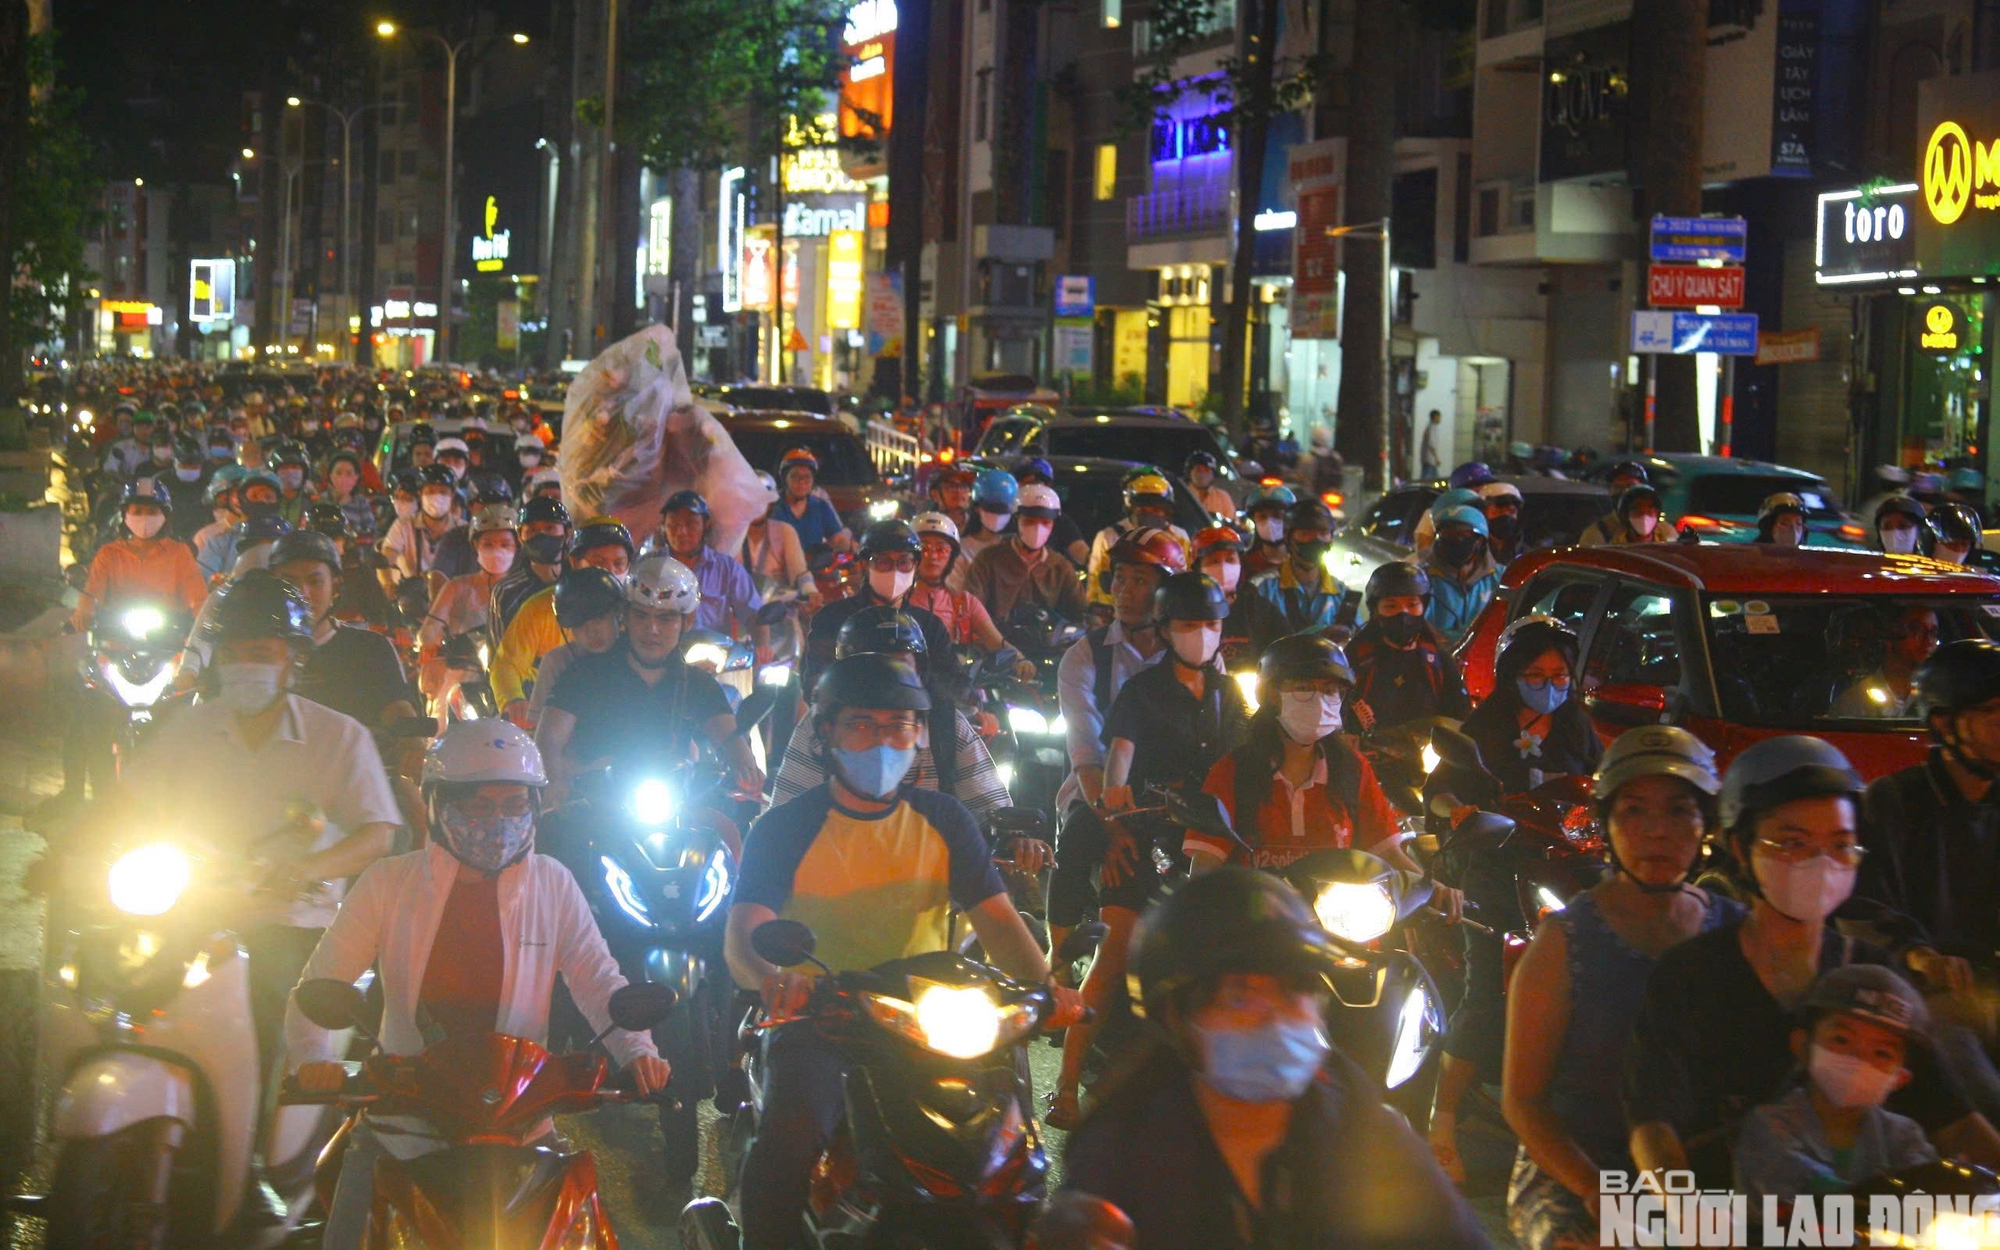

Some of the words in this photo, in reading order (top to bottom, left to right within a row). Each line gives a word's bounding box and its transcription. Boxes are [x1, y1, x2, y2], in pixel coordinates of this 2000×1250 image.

[1844, 201, 1905, 243] toro
[1652, 271, 1675, 298] CHÚ
[1684, 275, 1716, 299] QUAN
[1717, 271, 1741, 299] SÁT
